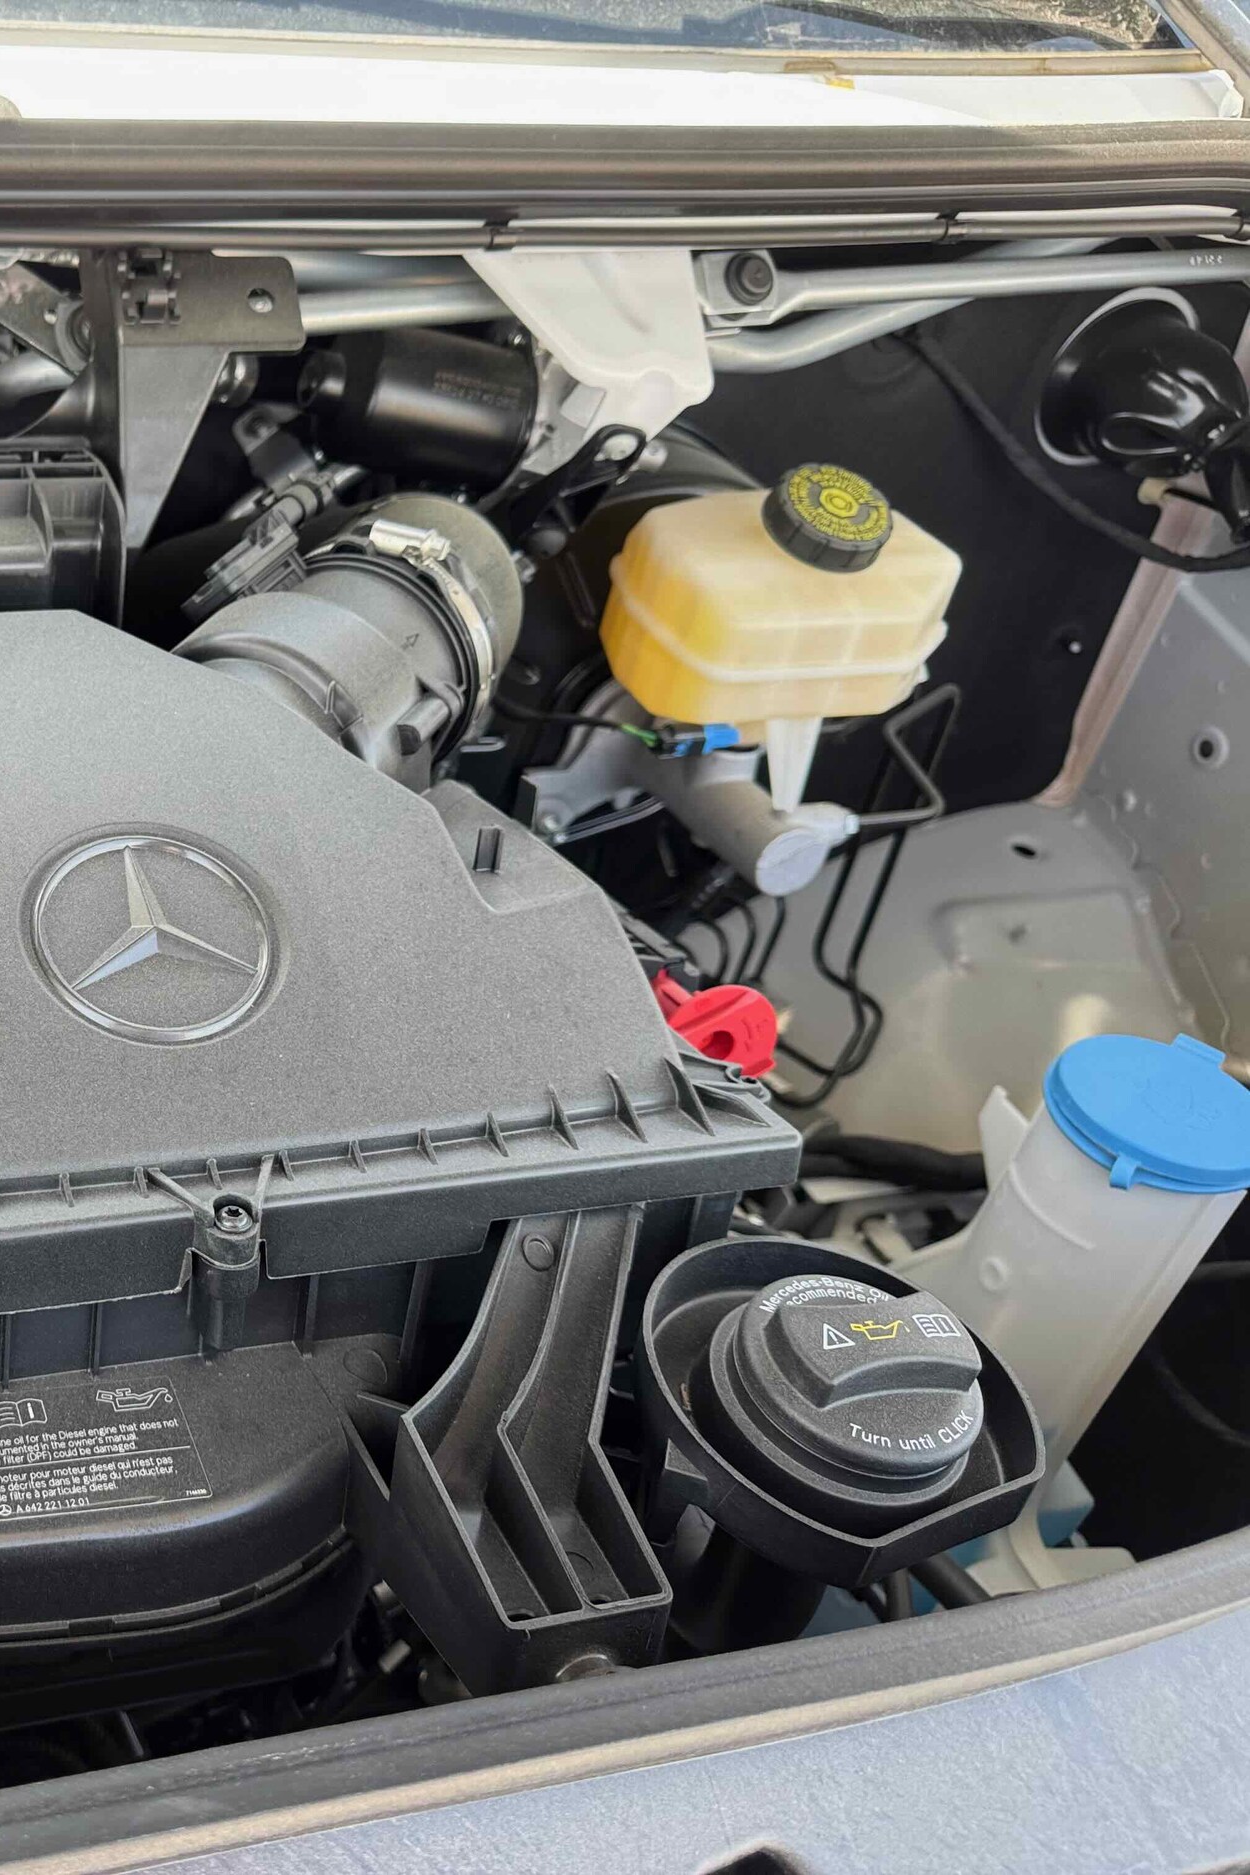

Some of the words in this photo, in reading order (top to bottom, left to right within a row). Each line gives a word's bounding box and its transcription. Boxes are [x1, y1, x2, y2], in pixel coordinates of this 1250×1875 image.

[759, 1277, 864, 1314] Mercedes-Benz
[785, 1288, 877, 1306] ecommended
[13, 1435, 24, 1445] oil
[25, 1434, 39, 1443] for
[42, 1432, 58, 1442] the
[58, 1428, 87, 1439] Diesel
[87, 1425, 117, 1437] engine
[118, 1422, 138, 1433] that
[139, 1420, 162, 1431] does
[162, 1417, 179, 1428] not
[41, 1442, 50, 1451] in
[50, 1440, 66, 1450] the
[67, 1435, 104, 1448] owner's
[105, 1431, 139, 1444] manual.
[849, 1422, 891, 1448] Turn
[899, 1434, 936, 1450] until
[937, 1410, 974, 1443] CLICK
[3, 1454, 24, 1465] filter
[26, 1450, 52, 1463] (DPF)
[53, 1447, 78, 1458] could
[78, 1446, 92, 1455] be
[93, 1440, 138, 1453] damaged.
[7, 1480, 47, 1492] décrites
[48, 1477, 70, 1487] dans
[71, 1475, 81, 1485] le
[82, 1471, 108, 1485] guide
[109, 1470, 122, 1480] du
[123, 1465, 178, 1479] conducteur,
[30, 1469, 51, 1480] pour
[53, 1465, 87, 1477] moteur
[89, 1461, 117, 1473] diesel
[117, 1459, 131, 1471] qui
[132, 1456, 155, 1468] n'est
[155, 1455, 173, 1467] pas
[9, 1490, 32, 1501] filtre
[34, 1488, 41, 1499] à
[41, 1485, 88, 1500] particules
[89, 1479, 119, 1492] diesel.
[15, 1504, 24, 1514] A
[25, 1502, 43, 1513] 642
[44, 1500, 62, 1511] 221
[65, 1498, 77, 1508] 12
[78, 1497, 90, 1507] 01
